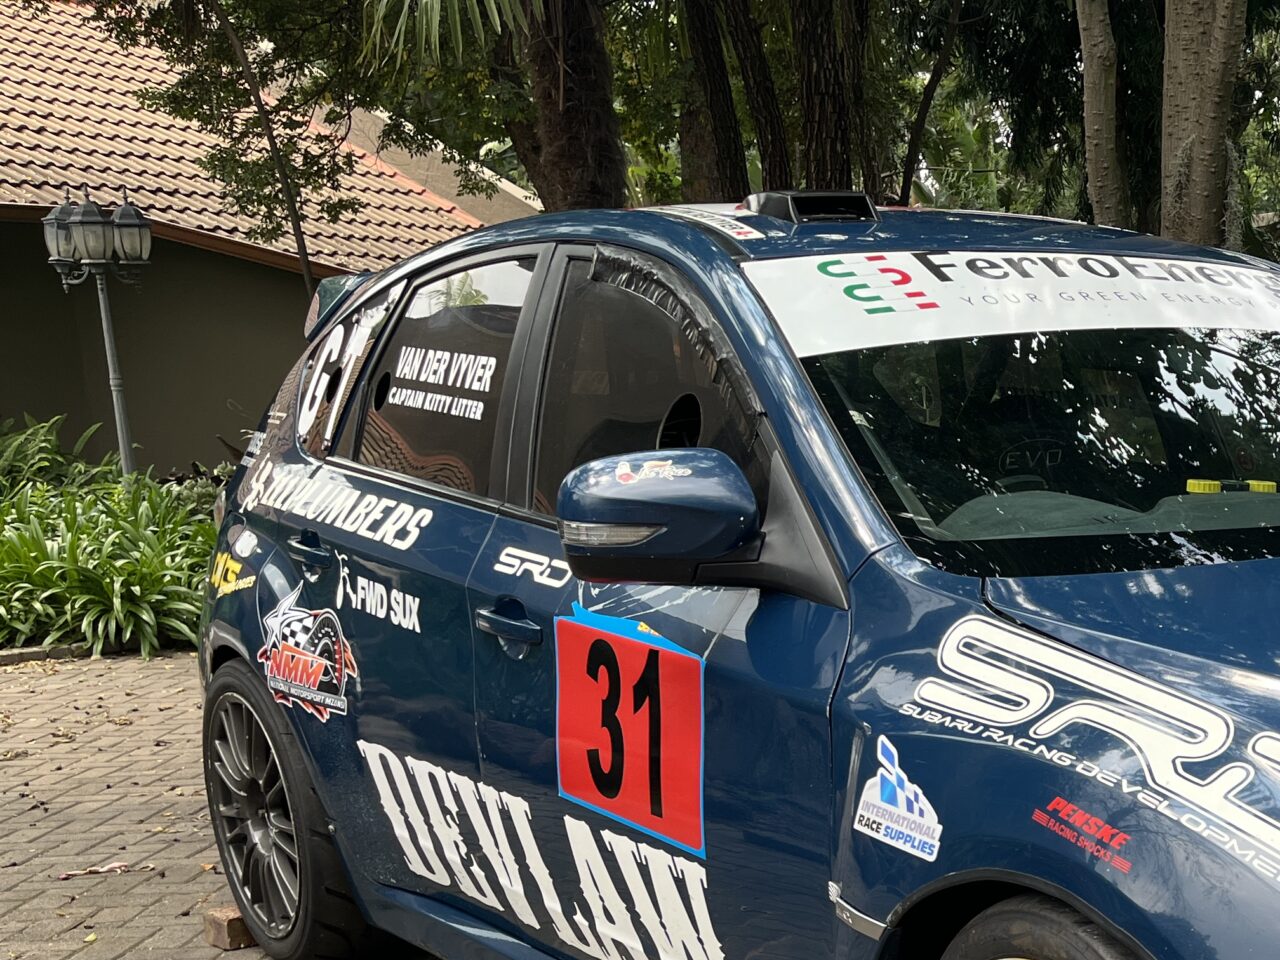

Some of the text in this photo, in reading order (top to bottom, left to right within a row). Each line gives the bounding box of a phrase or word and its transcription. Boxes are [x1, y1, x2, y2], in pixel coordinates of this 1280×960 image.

[960, 293, 1042, 306] YOUR
[1058, 291, 1148, 302] GREEN
[1161, 292, 1256, 308] ENERGY
[396, 346, 496, 392] VAN DER VYVER
[388, 386, 484, 420] CAPTAIN KITTY LITTER
[493, 546, 573, 588] SRD
[357, 576, 421, 633] FWD SUX
[269, 647, 326, 690] NMM
[586, 638, 664, 819] 31
[899, 703, 984, 734] SUBARU
[858, 814, 936, 857] RACE SUPPLIES
[861, 799, 936, 842] INTERNATIONAL
[1046, 796, 1131, 850] PENSKE
[1047, 818, 1112, 863] RACING SHOCKS
